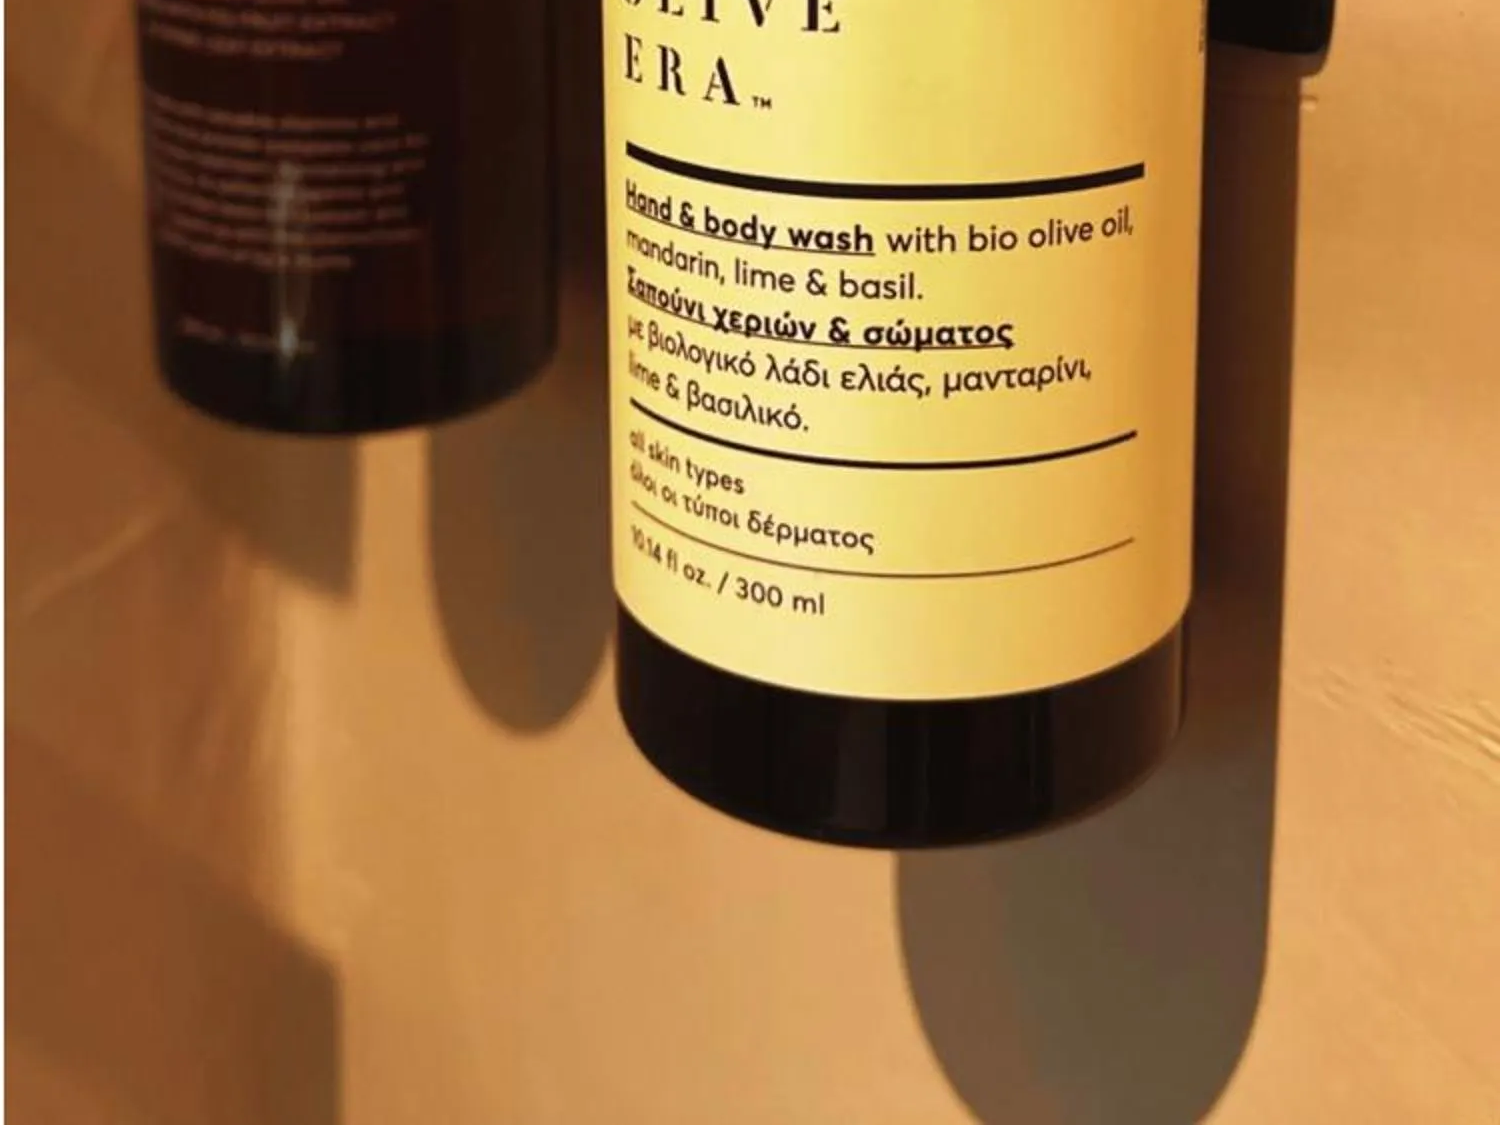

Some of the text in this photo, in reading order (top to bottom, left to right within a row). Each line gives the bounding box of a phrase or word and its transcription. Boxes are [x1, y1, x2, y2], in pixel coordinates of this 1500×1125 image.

[626, 179, 1133, 253] Hand & body wash with bio olive oil,
[627, 229, 924, 300] mandarin, lime & basil.
[627, 264, 1015, 352] Σαπούνι χεριών & σώματος
[628, 314, 1092, 399] με βιολογικό λάδι ελιάς, μανταρίνι,
[628, 350, 809, 433] lime & βασιλικό.
[629, 429, 746, 495] all skin types
[661, 485, 678, 507] οι
[682, 494, 741, 530] τύποι
[747, 509, 876, 555] δέρματος
[666, 547, 678, 573] fl
[683, 561, 712, 588] oz.
[716, 570, 730, 596] /
[736, 576, 783, 609] 300
[792, 592, 825, 616] ml
